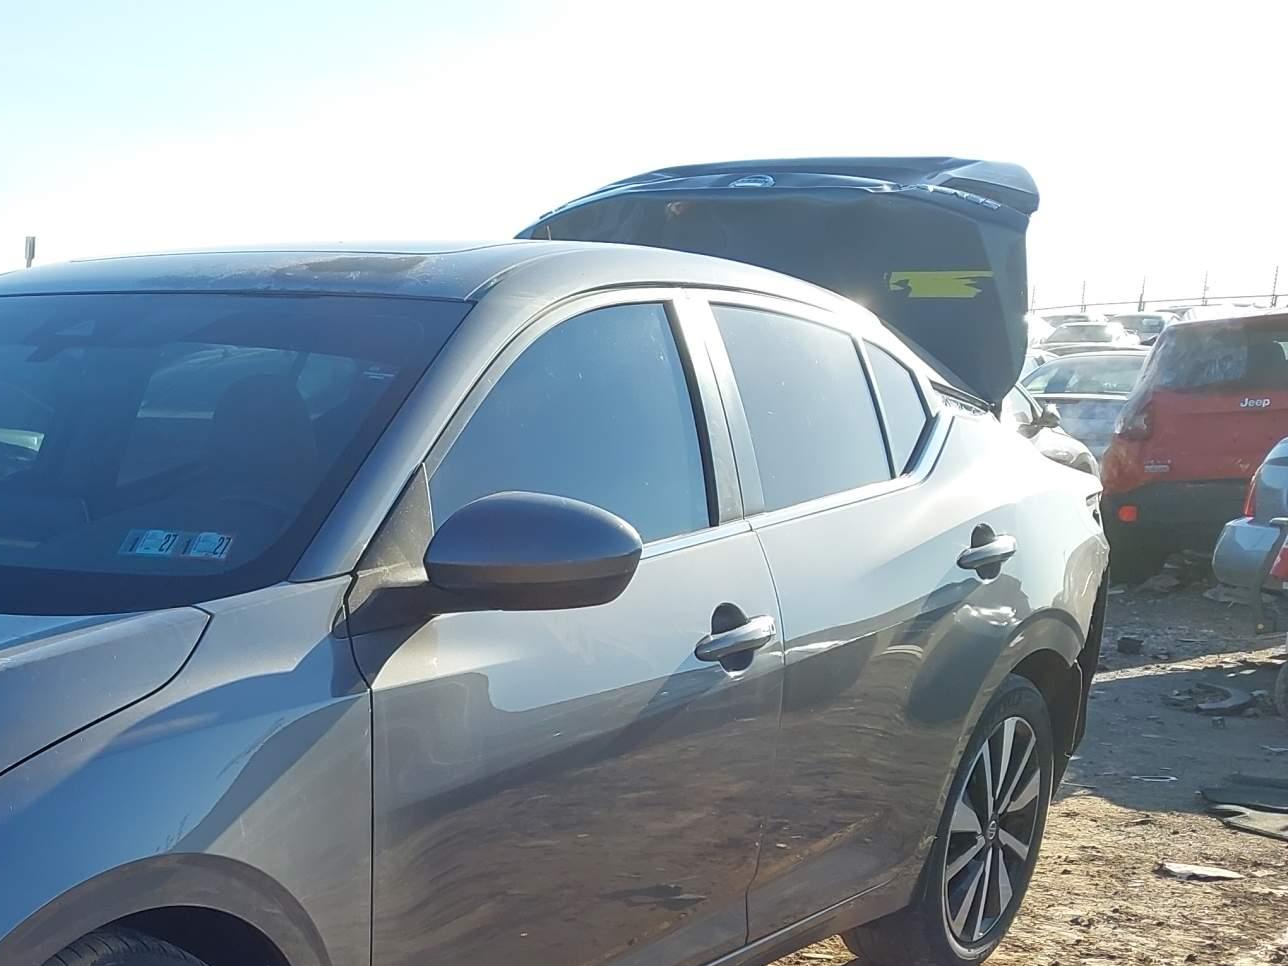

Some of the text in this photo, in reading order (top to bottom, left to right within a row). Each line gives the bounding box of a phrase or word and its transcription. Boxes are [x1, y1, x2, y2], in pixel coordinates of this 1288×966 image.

[1239, 397, 1271, 408] Jeep
[157, 533, 179, 553] 27
[212, 536, 232, 558] 27
